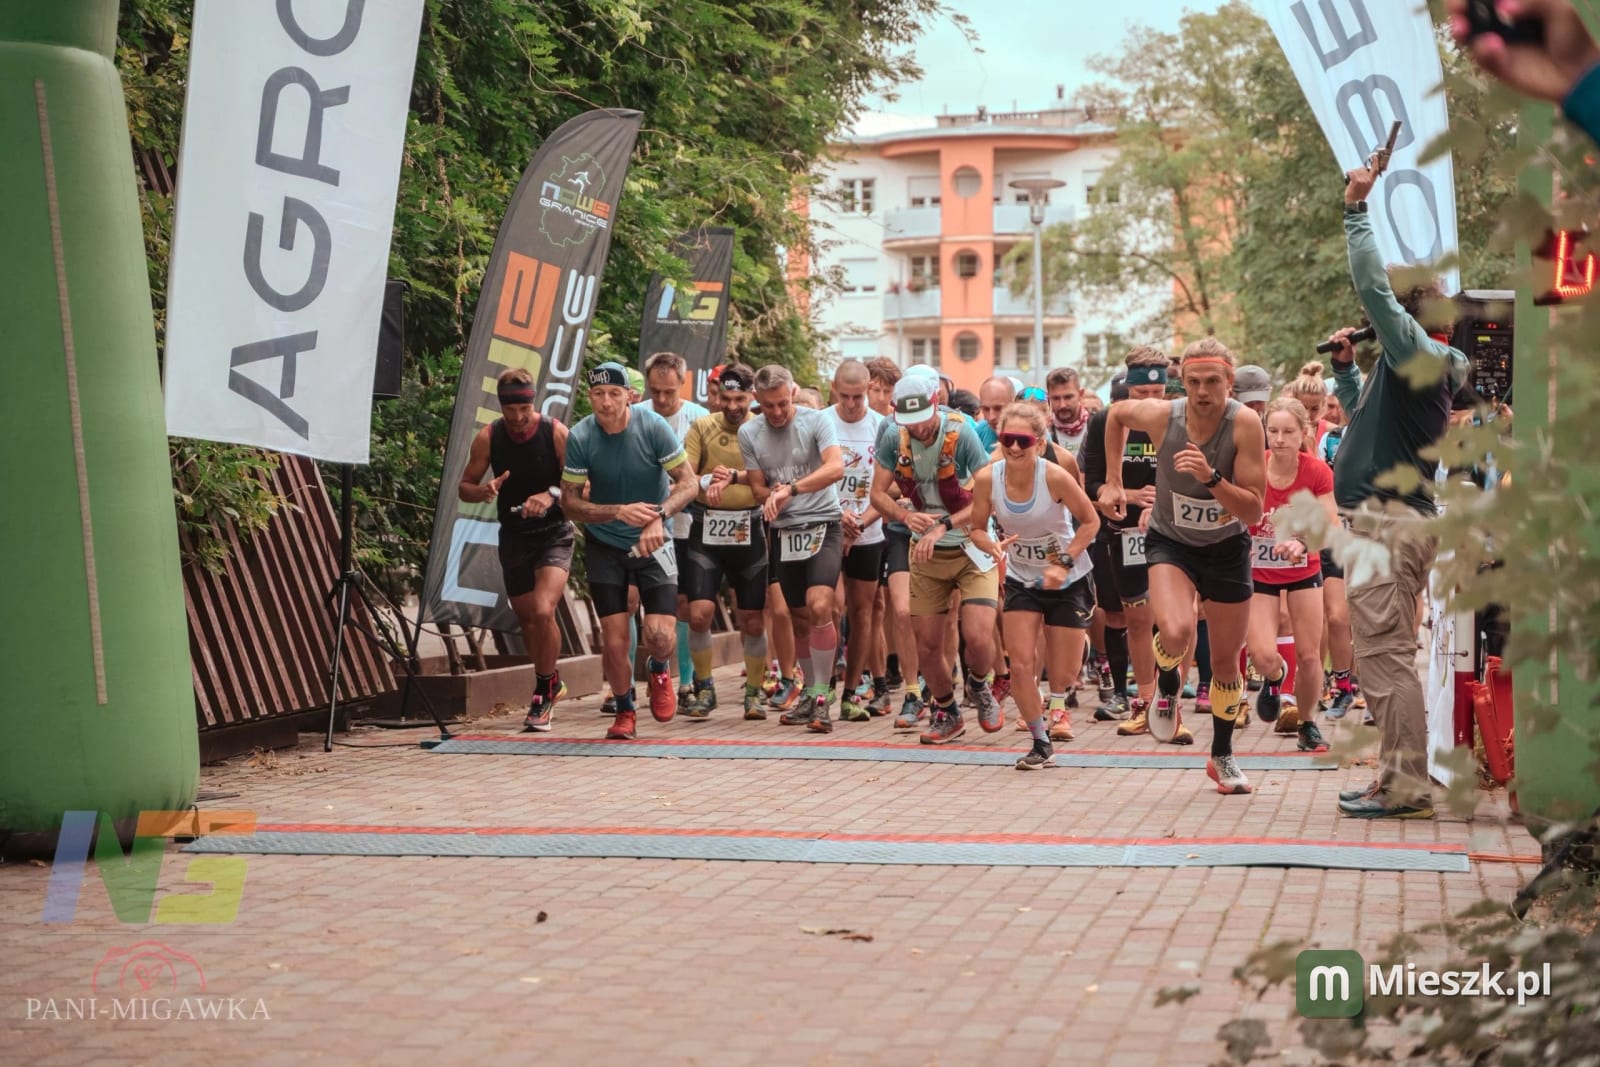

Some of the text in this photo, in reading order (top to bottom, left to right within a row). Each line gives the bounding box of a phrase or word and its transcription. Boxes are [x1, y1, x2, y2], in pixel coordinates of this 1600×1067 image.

[539, 197, 608, 229] GRANICE
[1181, 504, 1218, 523] 276
[709, 519, 737, 537] 222
[788, 533, 812, 552] 102
[1013, 542, 1046, 560] 275
[1128, 536, 1147, 556] 28
